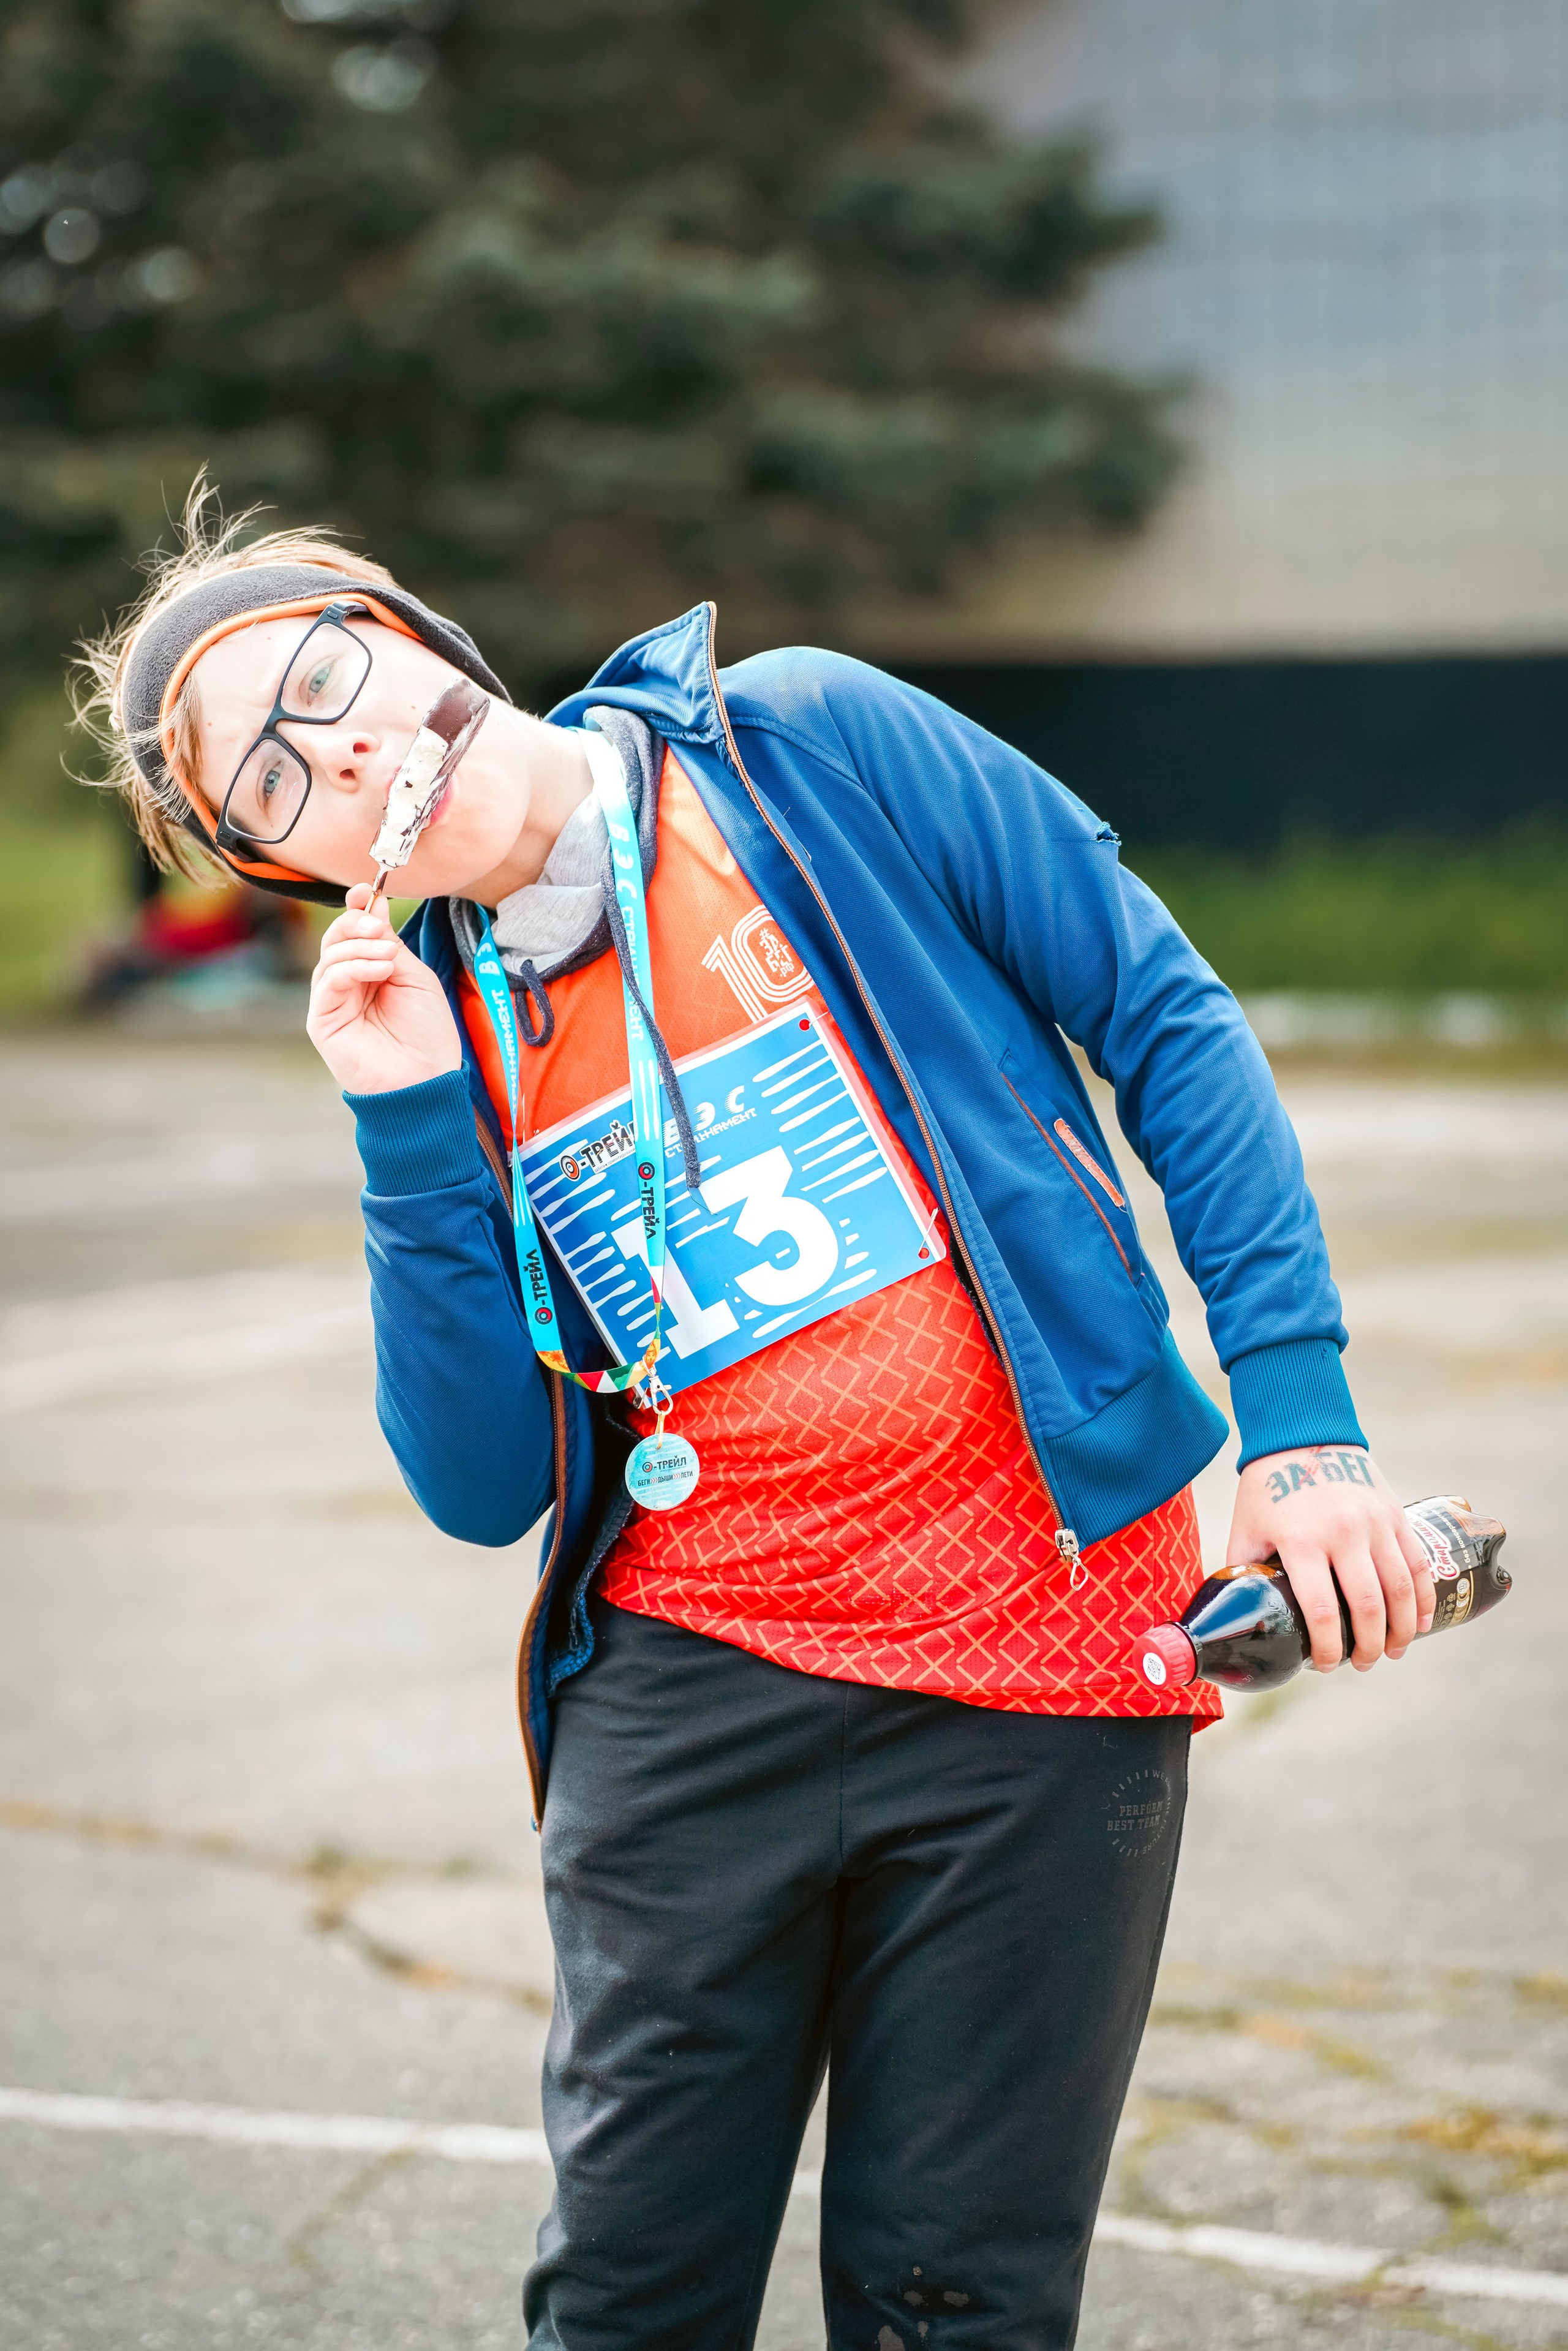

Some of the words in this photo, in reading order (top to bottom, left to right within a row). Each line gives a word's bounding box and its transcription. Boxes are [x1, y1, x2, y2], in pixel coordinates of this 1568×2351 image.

[701, 904, 815, 1025] 10
[611, 1145, 839, 1360] 13
[638, 1478, 650, 1487] БЕГИ
[658, 1474, 673, 1484] ДЫШИ
[680, 1470, 693, 1479] ЛЕТИ
[1119, 1800, 1164, 1817] PERFORM
[1107, 1819, 1135, 1832] BEST
[1137, 1814, 1161, 1830] TEAM
